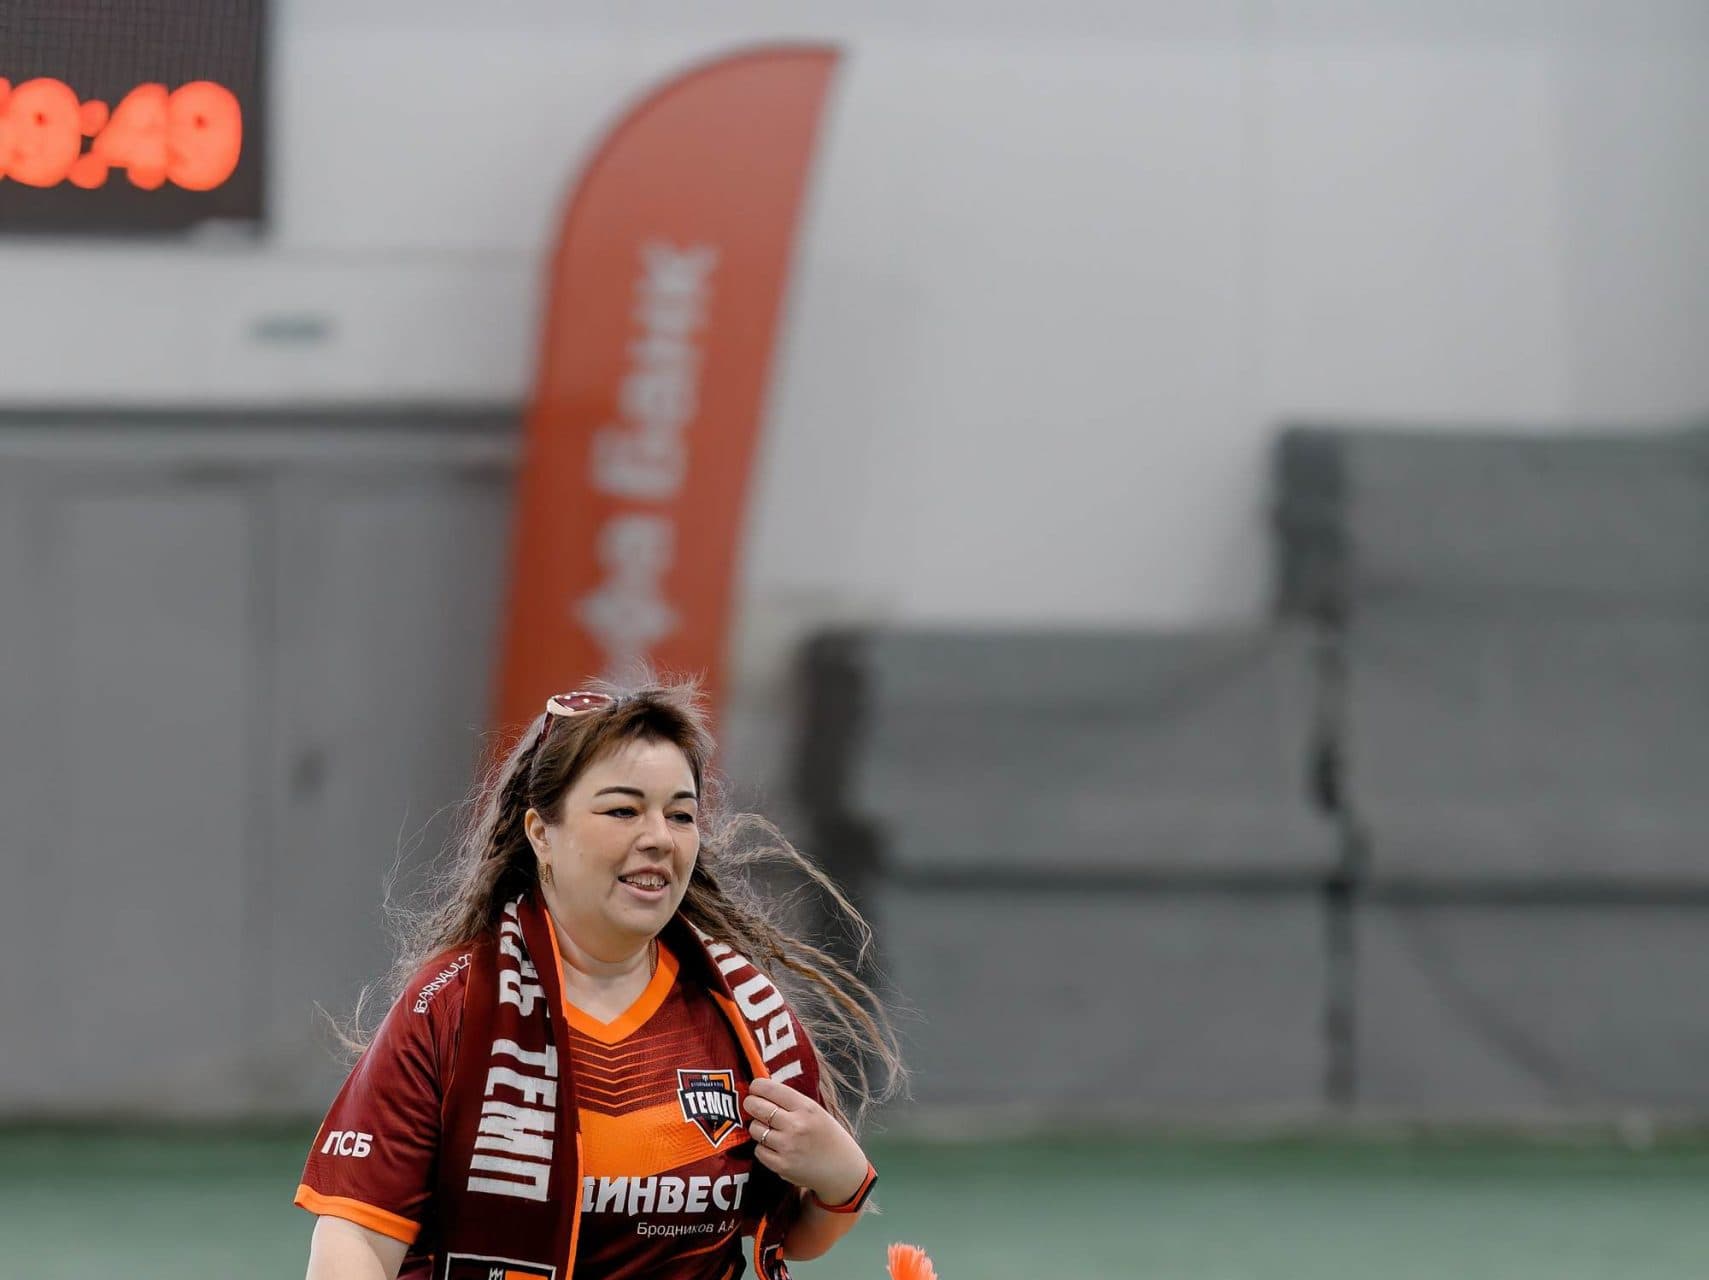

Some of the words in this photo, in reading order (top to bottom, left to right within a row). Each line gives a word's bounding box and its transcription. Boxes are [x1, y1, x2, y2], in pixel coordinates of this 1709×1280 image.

[684, 1091, 737, 1120] ТЕМП
[467, 1038, 558, 1202] ТЕМП
[320, 1130, 373, 1158] ПСБ
[637, 1222, 714, 1237] Бродников
